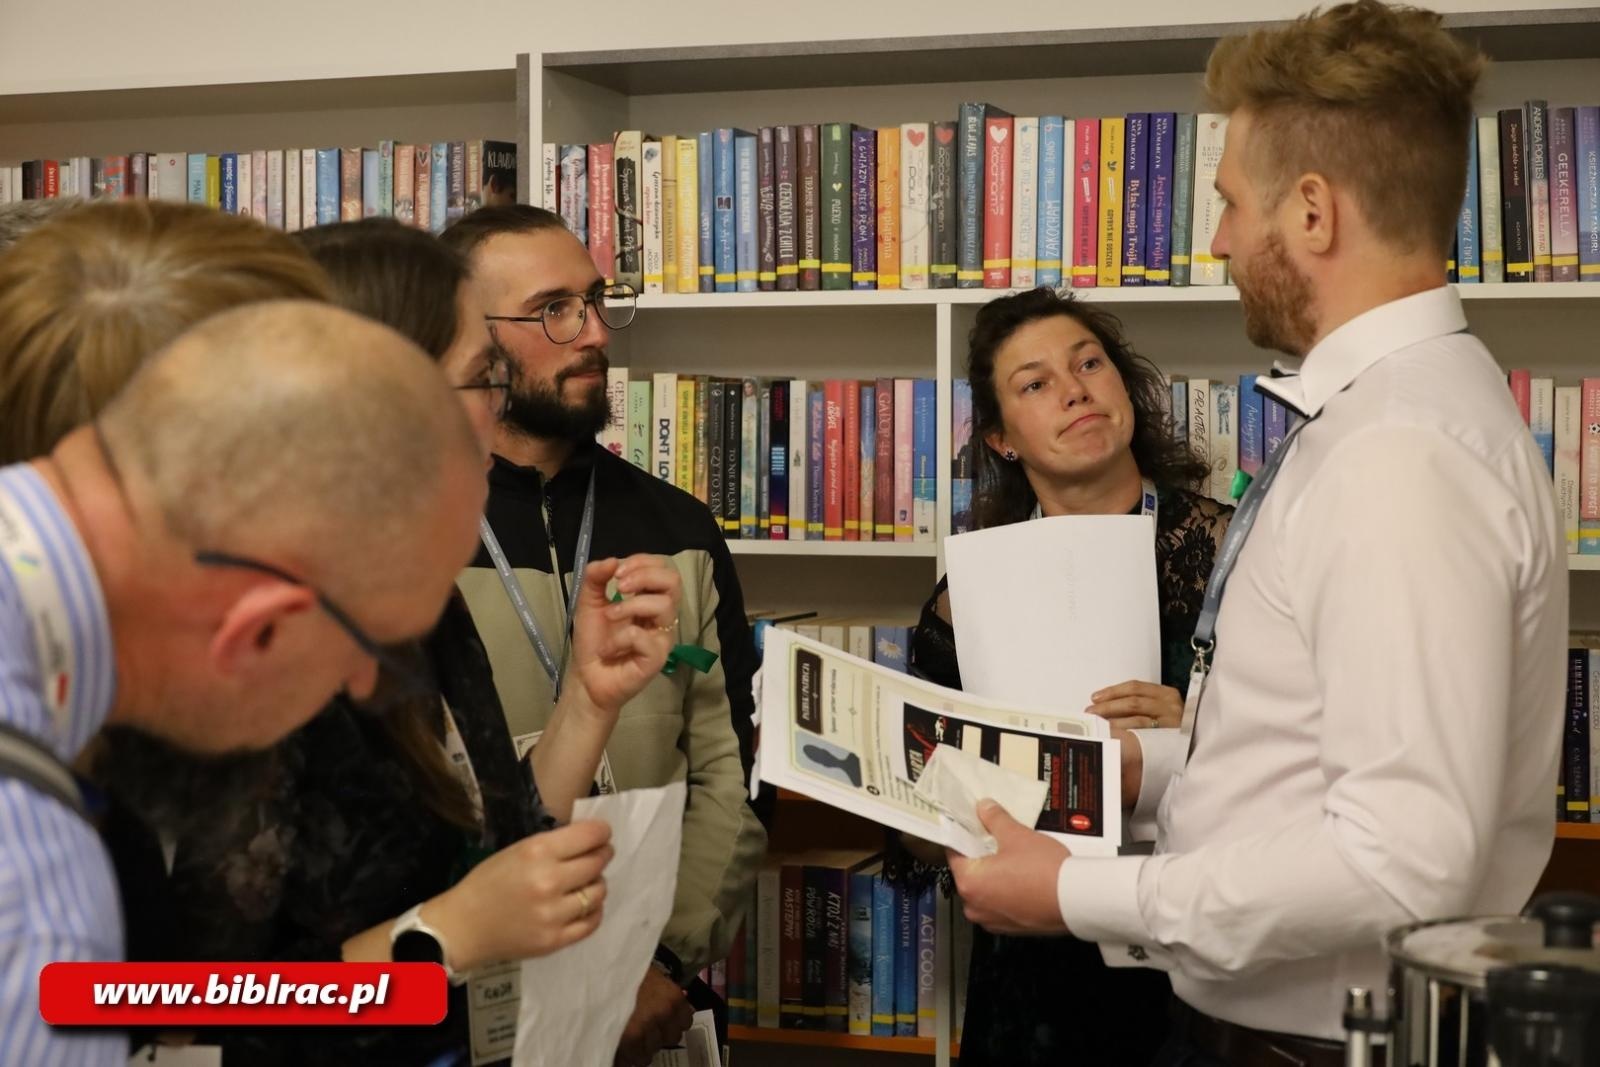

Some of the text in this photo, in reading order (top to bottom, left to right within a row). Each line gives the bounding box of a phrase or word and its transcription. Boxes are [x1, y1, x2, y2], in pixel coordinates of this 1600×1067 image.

[858, 145, 868, 184] GWIAZDY
[1130, 119, 1138, 171] KACZMARCZYK
[1533, 107, 1545, 180] ANDREA PORTES
[779, 182, 793, 226] CZEKOLADA
[859, 187, 868, 211] NIECH
[1557, 152, 1571, 239] GEEKERELLA
[805, 214, 814, 260] TRUSKAWKAM
[1044, 200, 1061, 257] ZAKOCHAM
[1126, 236, 1138, 267] Trójk
[1590, 215, 1599, 254] FANGIRL
[614, 381, 625, 431] GENTLE
[877, 391, 892, 438] GALOP
[1194, 388, 1206, 436] PRACTICE
[659, 461, 671, 482] LOV
[728, 448, 736, 461] TO
[728, 463, 737, 479] NIE
[710, 446, 722, 514] CZY TO SEN
[826, 891, 843, 922] KTOŚ
[920, 913, 935, 995] ACT COOL
